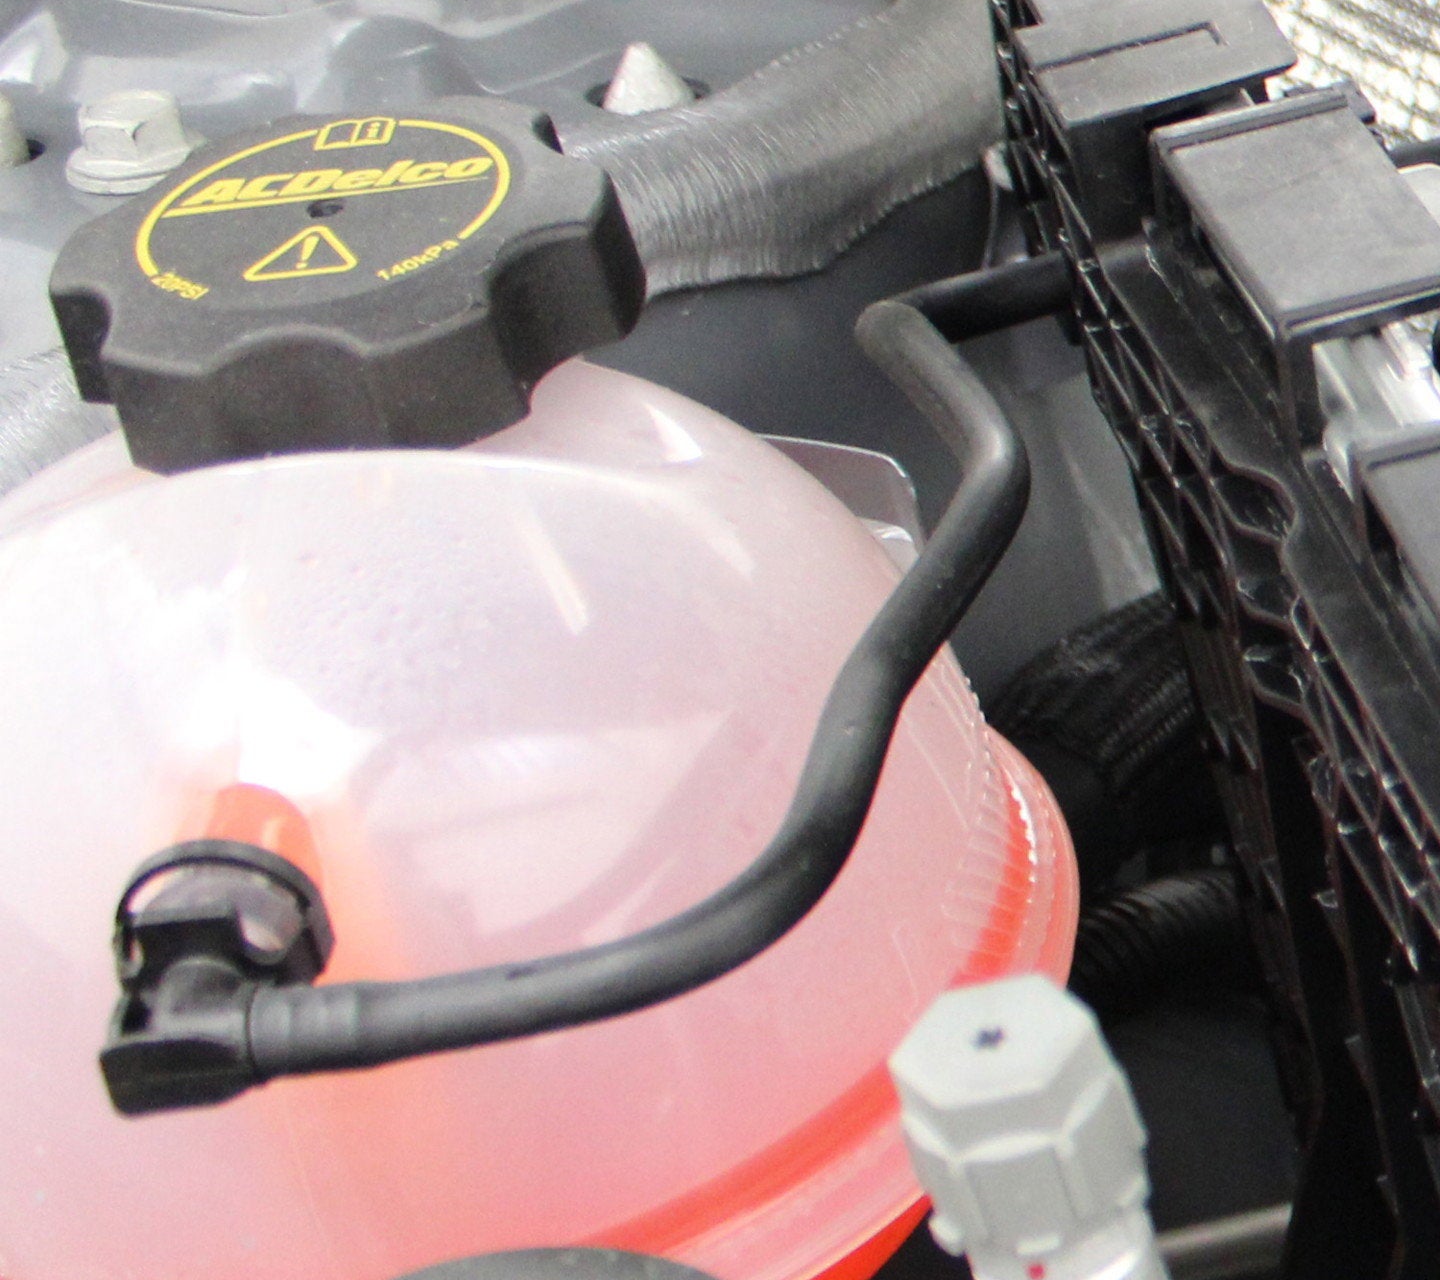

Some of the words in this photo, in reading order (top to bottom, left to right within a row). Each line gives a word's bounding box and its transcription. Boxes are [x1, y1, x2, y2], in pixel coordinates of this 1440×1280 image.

[180, 156, 494, 208] ACDelco
[376, 238, 460, 282] 140kPa
[152, 269, 210, 300] 20PSI
